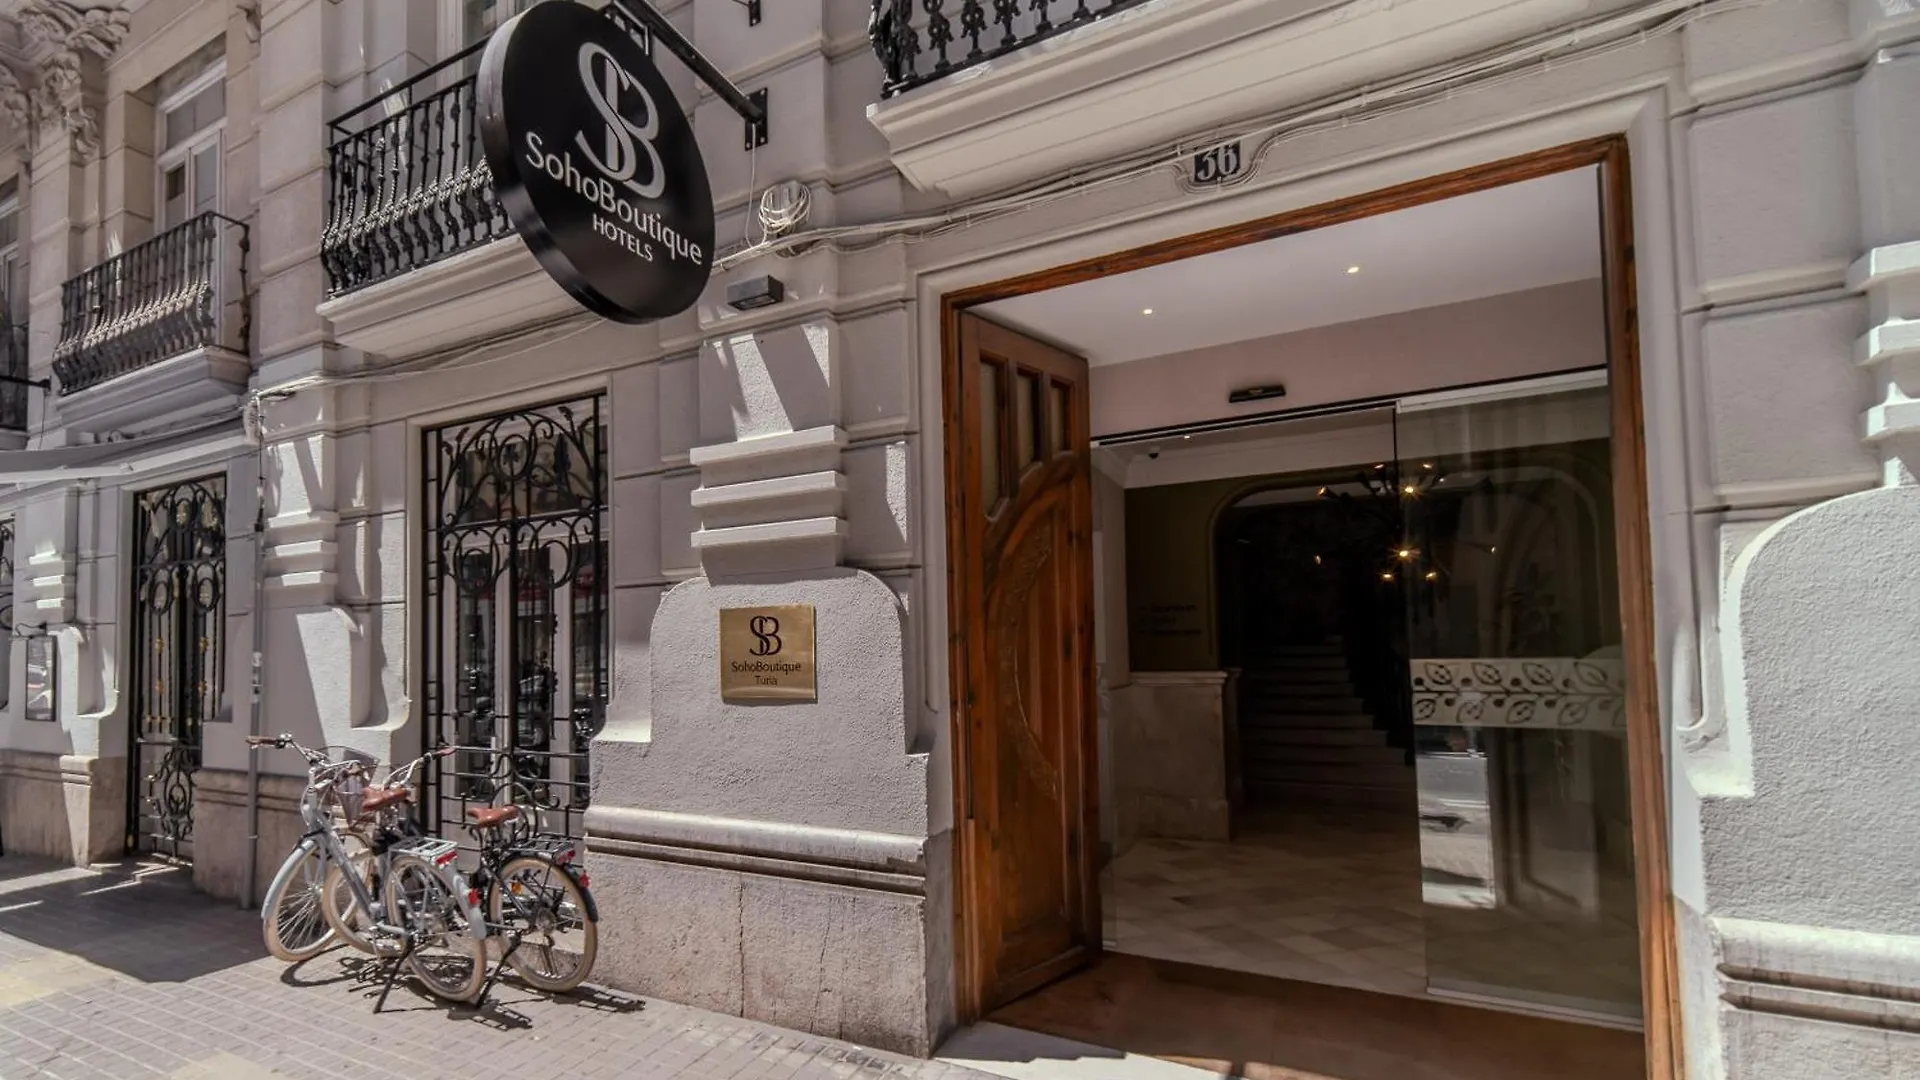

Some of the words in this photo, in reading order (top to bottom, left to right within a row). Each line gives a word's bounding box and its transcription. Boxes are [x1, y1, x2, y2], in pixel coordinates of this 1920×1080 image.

[525, 131, 703, 265] SohoBoutique
[592, 213, 654, 262] HOTELS
[731, 661, 802, 676] SohoBoutique
